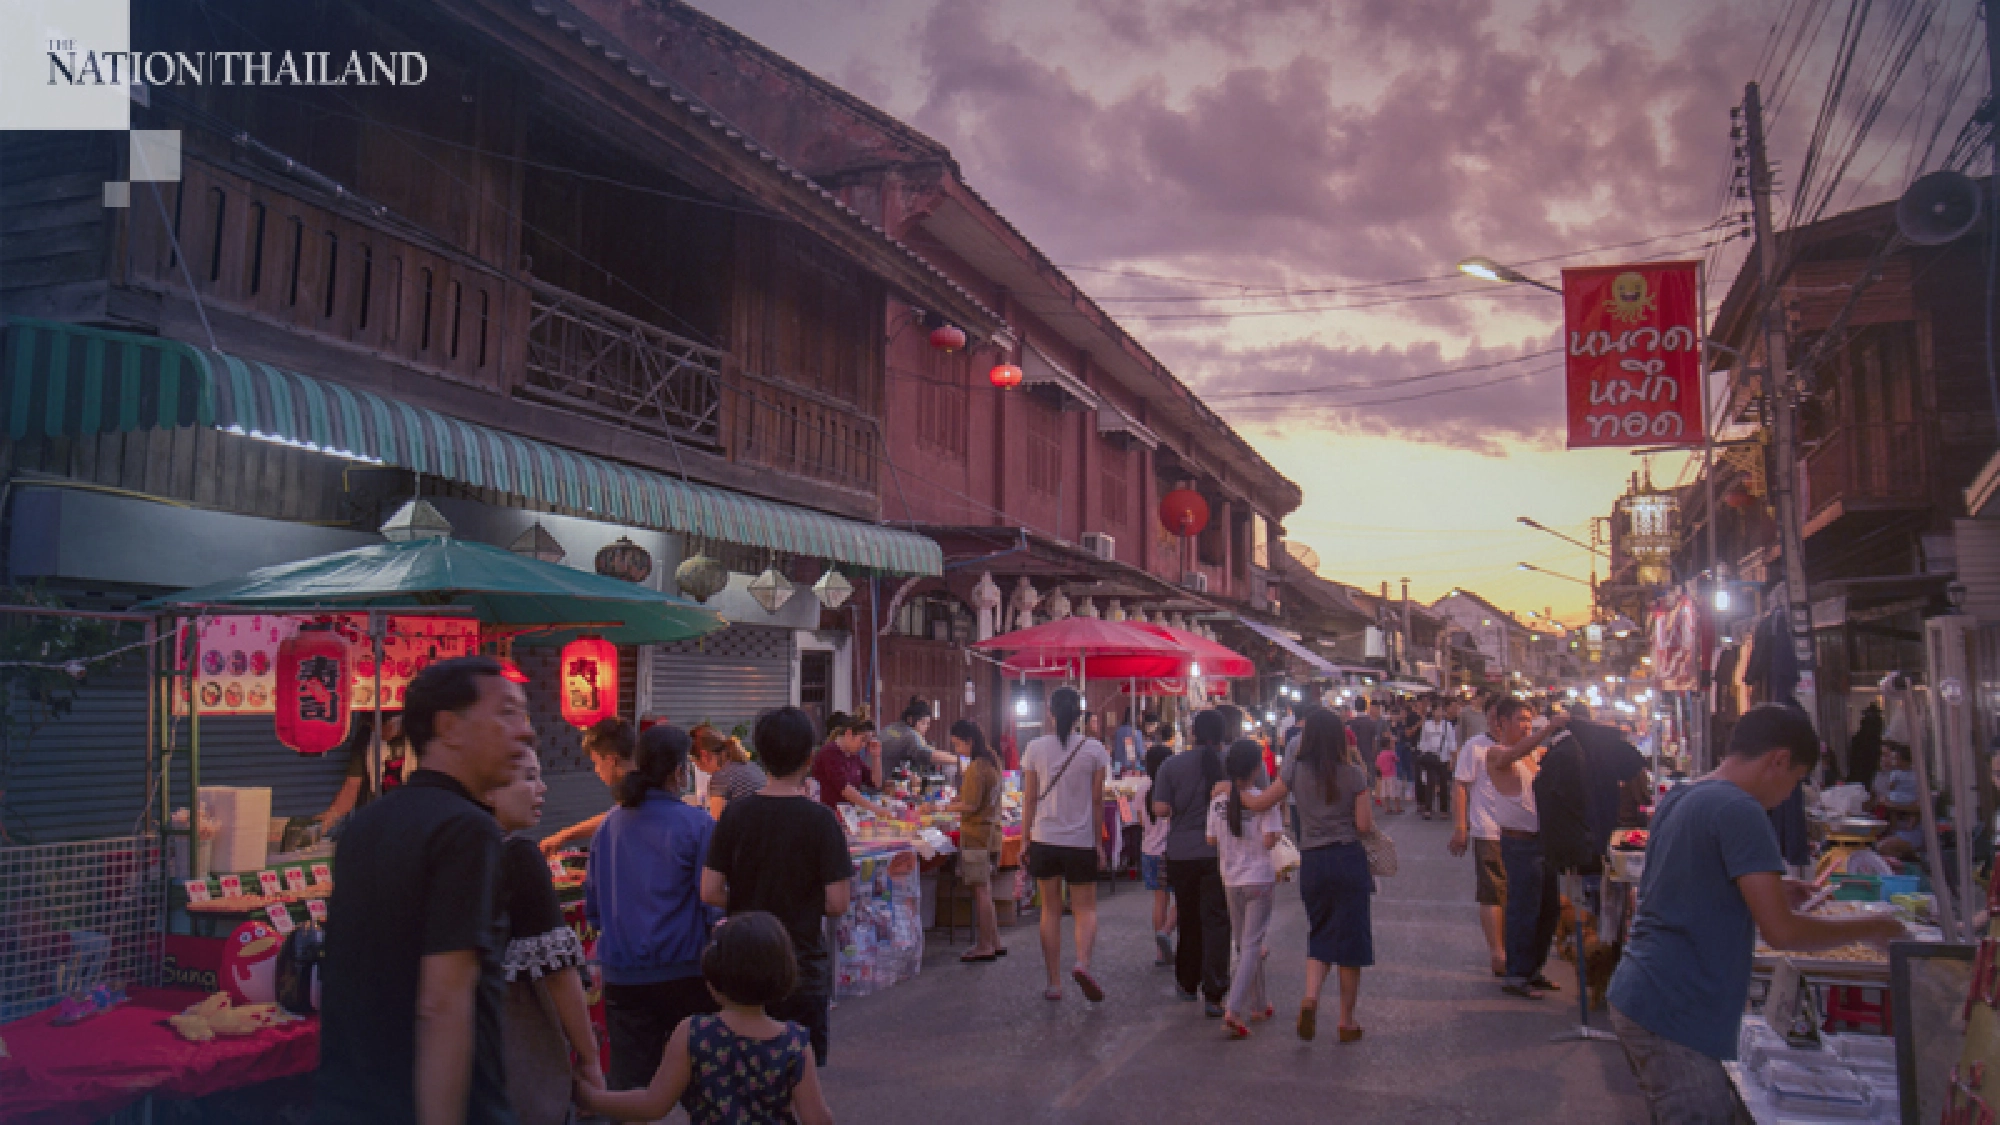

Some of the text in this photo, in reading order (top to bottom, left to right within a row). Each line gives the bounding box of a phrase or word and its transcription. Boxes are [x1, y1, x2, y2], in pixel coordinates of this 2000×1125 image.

[1569, 324, 1694, 357] หนวด
[1590, 358, 1679, 406] หมึก
[1586, 410, 1685, 439] ทอด
